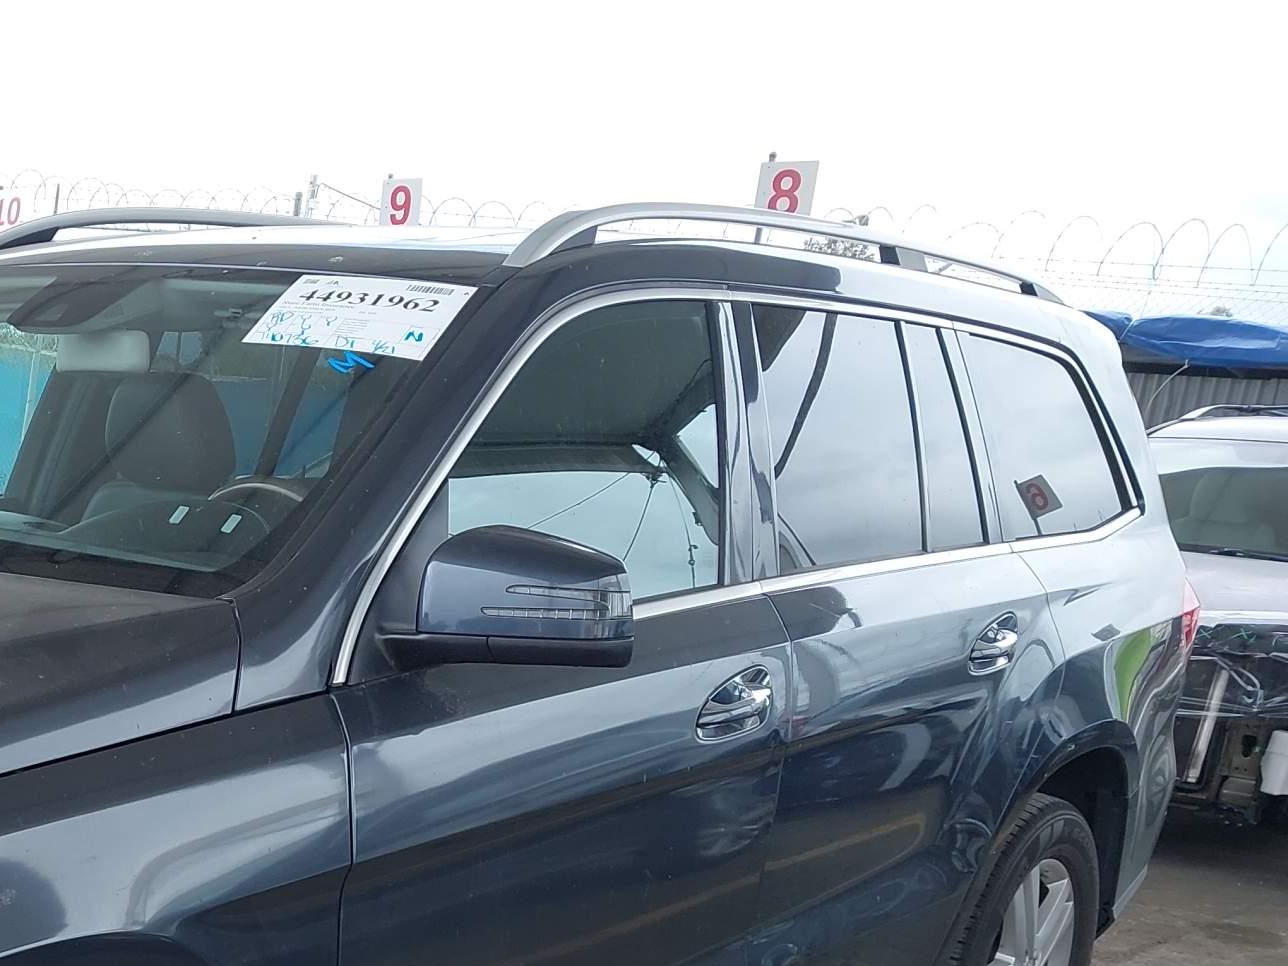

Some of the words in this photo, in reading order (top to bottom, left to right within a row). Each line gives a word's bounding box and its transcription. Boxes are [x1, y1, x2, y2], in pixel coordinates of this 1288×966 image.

[389, 185, 412, 226] 9
[768, 168, 802, 213] 8
[299, 289, 440, 313] 44931962
